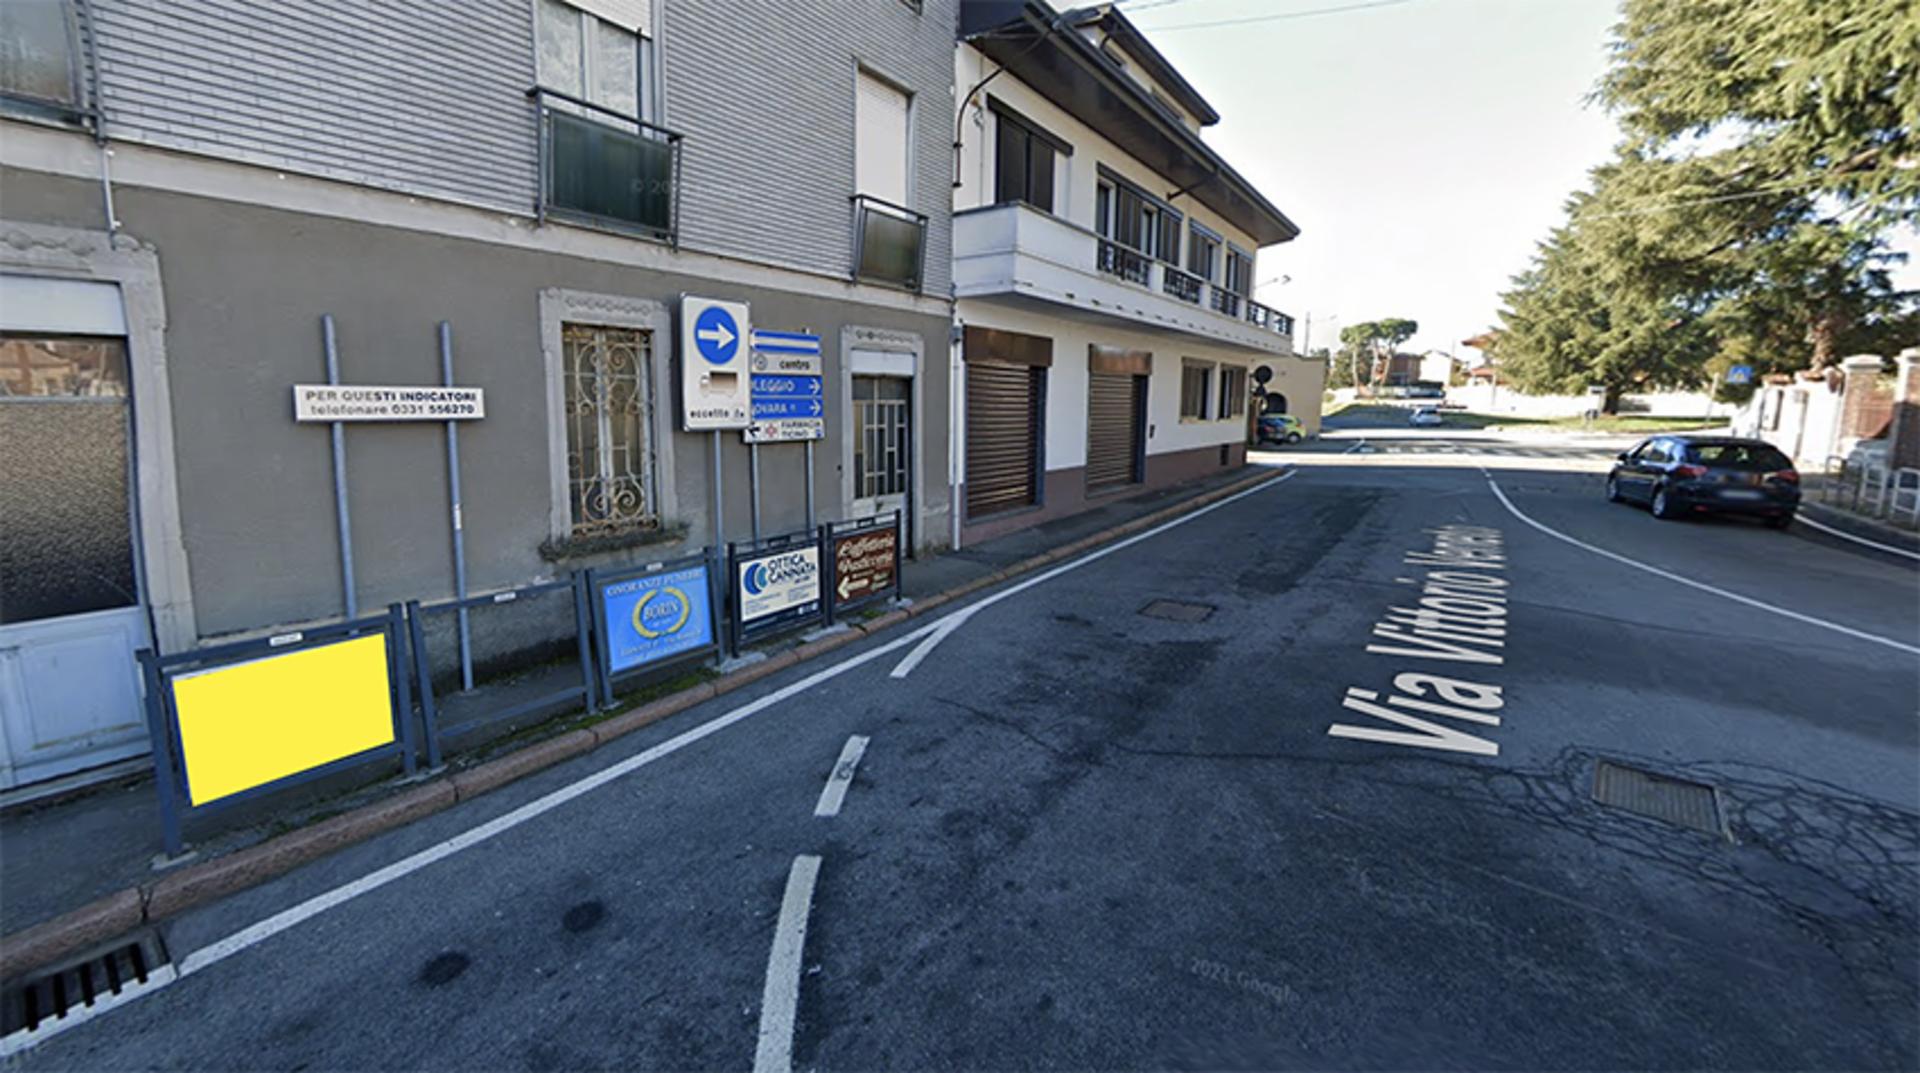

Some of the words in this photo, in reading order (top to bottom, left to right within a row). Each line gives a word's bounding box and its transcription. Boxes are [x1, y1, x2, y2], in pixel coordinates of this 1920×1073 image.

[779, 359, 811, 369] centro
[753, 379, 795, 392] LEGGIO
[306, 391, 338, 400] PER
[342, 391, 396, 401] QUESTI
[400, 391, 477, 402] INDICATORI
[311, 403, 387, 415] telefonare
[392, 404, 424, 414] 0331
[690, 409, 730, 418] eccetto
[767, 553, 806, 571] OTTICA
[768, 564, 816, 584] CANNATA
